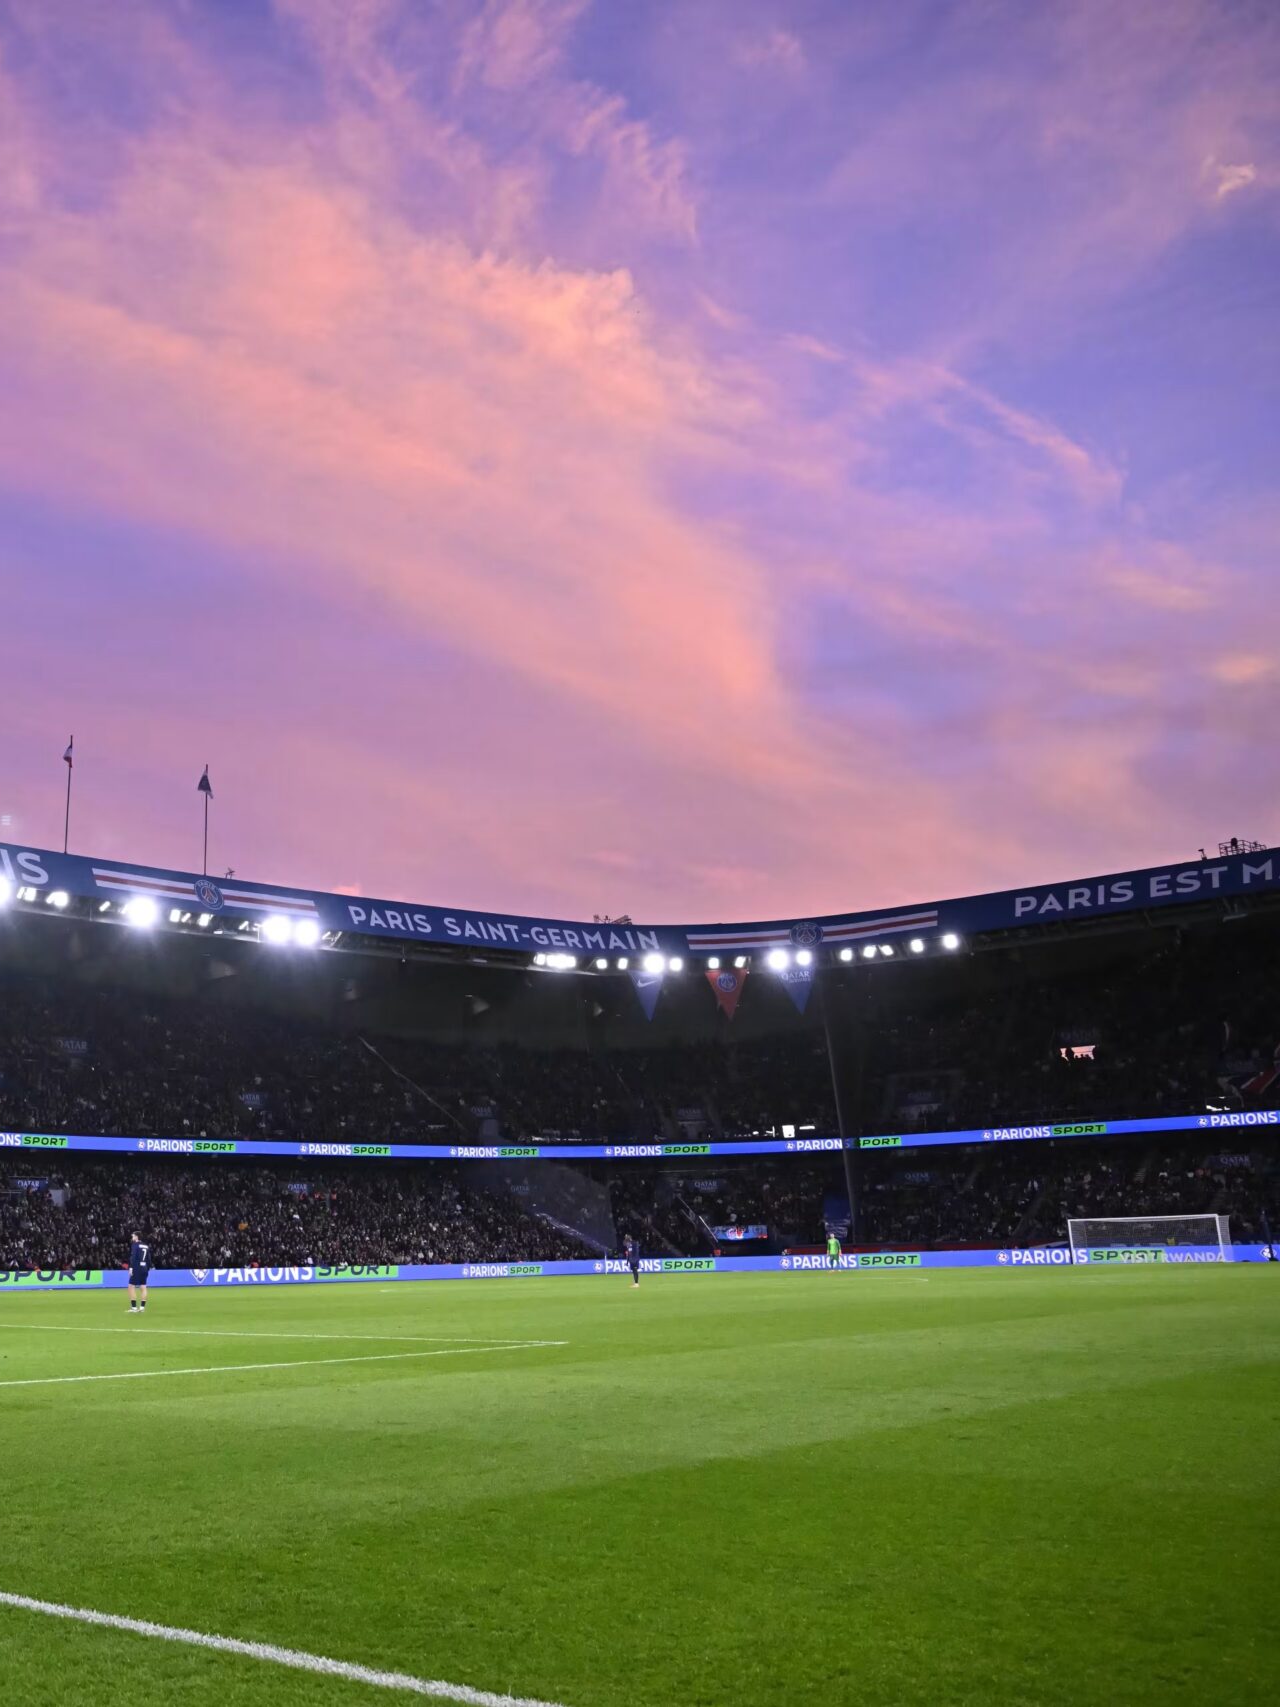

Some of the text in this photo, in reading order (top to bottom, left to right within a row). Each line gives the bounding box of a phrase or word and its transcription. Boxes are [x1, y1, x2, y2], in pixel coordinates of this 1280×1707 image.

[1014, 881, 1134, 917] PARIS
[1149, 866, 1228, 898] EST
[347, 905, 660, 950] PARIS SAINT-GERMAIN
[1210, 1111, 1278, 1126] PARIONS
[993, 1124, 1105, 1140] PARIONS SPORT
[23, 1136, 66, 1146] SPORT
[147, 1140, 234, 1152] PARIONS SPORT
[308, 1144, 389, 1155] PARIONS SPORT
[457, 1147, 538, 1157] PARIONS SPORT
[614, 1145, 709, 1156] PARIONS SPORT
[141, 1248, 147, 1261] 7
[860, 1255, 918, 1266] SPORT
[470, 1265, 541, 1277] PARIONS SPORT
[664, 1260, 713, 1270] SPORT
[213, 1267, 313, 1282] PARIONS
